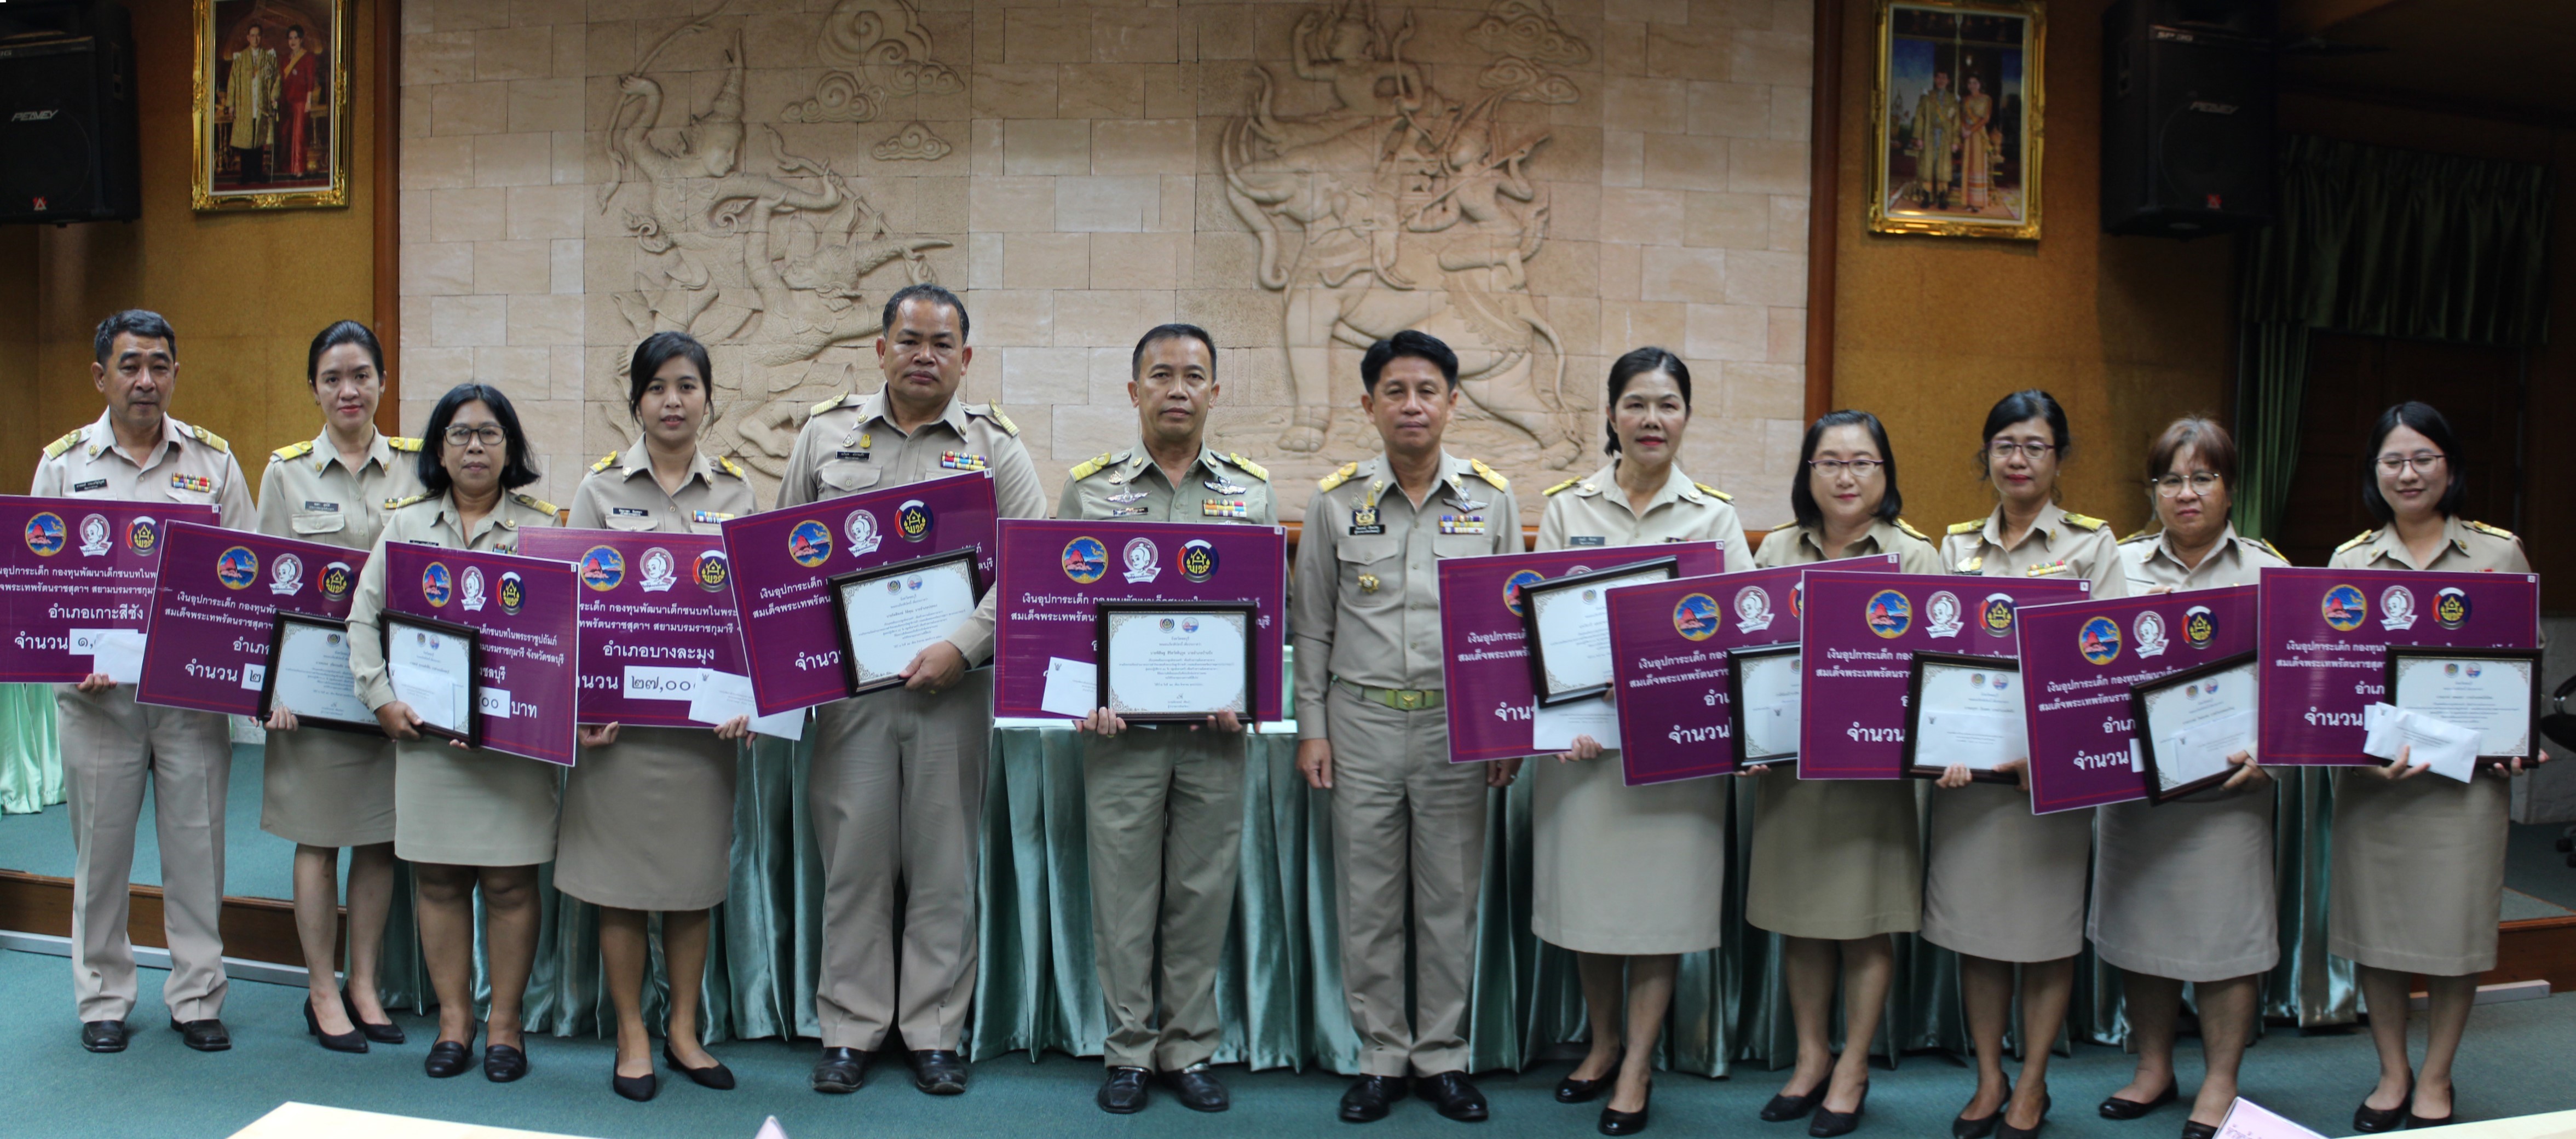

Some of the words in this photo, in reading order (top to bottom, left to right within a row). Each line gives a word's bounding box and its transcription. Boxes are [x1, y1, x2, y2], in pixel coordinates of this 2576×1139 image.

[11, 110, 59, 122] PEAVEY
[760, 576, 822, 599] เงินอุปการะเด็ก
[177, 591, 235, 608] เงินอุปการะเด็ก
[1023, 592, 1088, 607] เงินอุปการะเด็ก
[49, 603, 143, 619] อำเภอเกาะสีชัง
[165, 607, 273, 630] สมเด็จพระเทพรัตนราชสุดาฯ
[1011, 609, 1097, 622] สมเด็จพระเทพรัตน
[653, 623, 733, 636] สยามบรมราชกุมารี
[15, 631, 68, 649] จำนวน
[78, 637, 96, 649] ๑,
[2286, 640, 2350, 654] เงินอุปการะเด็ก
[527, 648, 564, 667] จังหวัดชลบุรี
[603, 640, 714, 665] อำเภอบางละมุง
[795, 650, 842, 671] จำนว
[1639, 650, 1707, 670] เงินอุปการะเด็ก
[1827, 648, 1893, 663] เงินอุปการะเด็ก
[185, 658, 238, 681] จำนวน
[631, 675, 695, 693] ๒๗,๐๐
[2047, 674, 2108, 694] เงินอุปการะเด็ก
[479, 692, 499, 709] ๐๐
[511, 701, 537, 718] บาท
[2304, 706, 2364, 726] จำนวน
[1669, 724, 1730, 744] จำนวน
[1847, 721, 1906, 742] จำนวน
[2073, 750, 2129, 770] จำนวน
